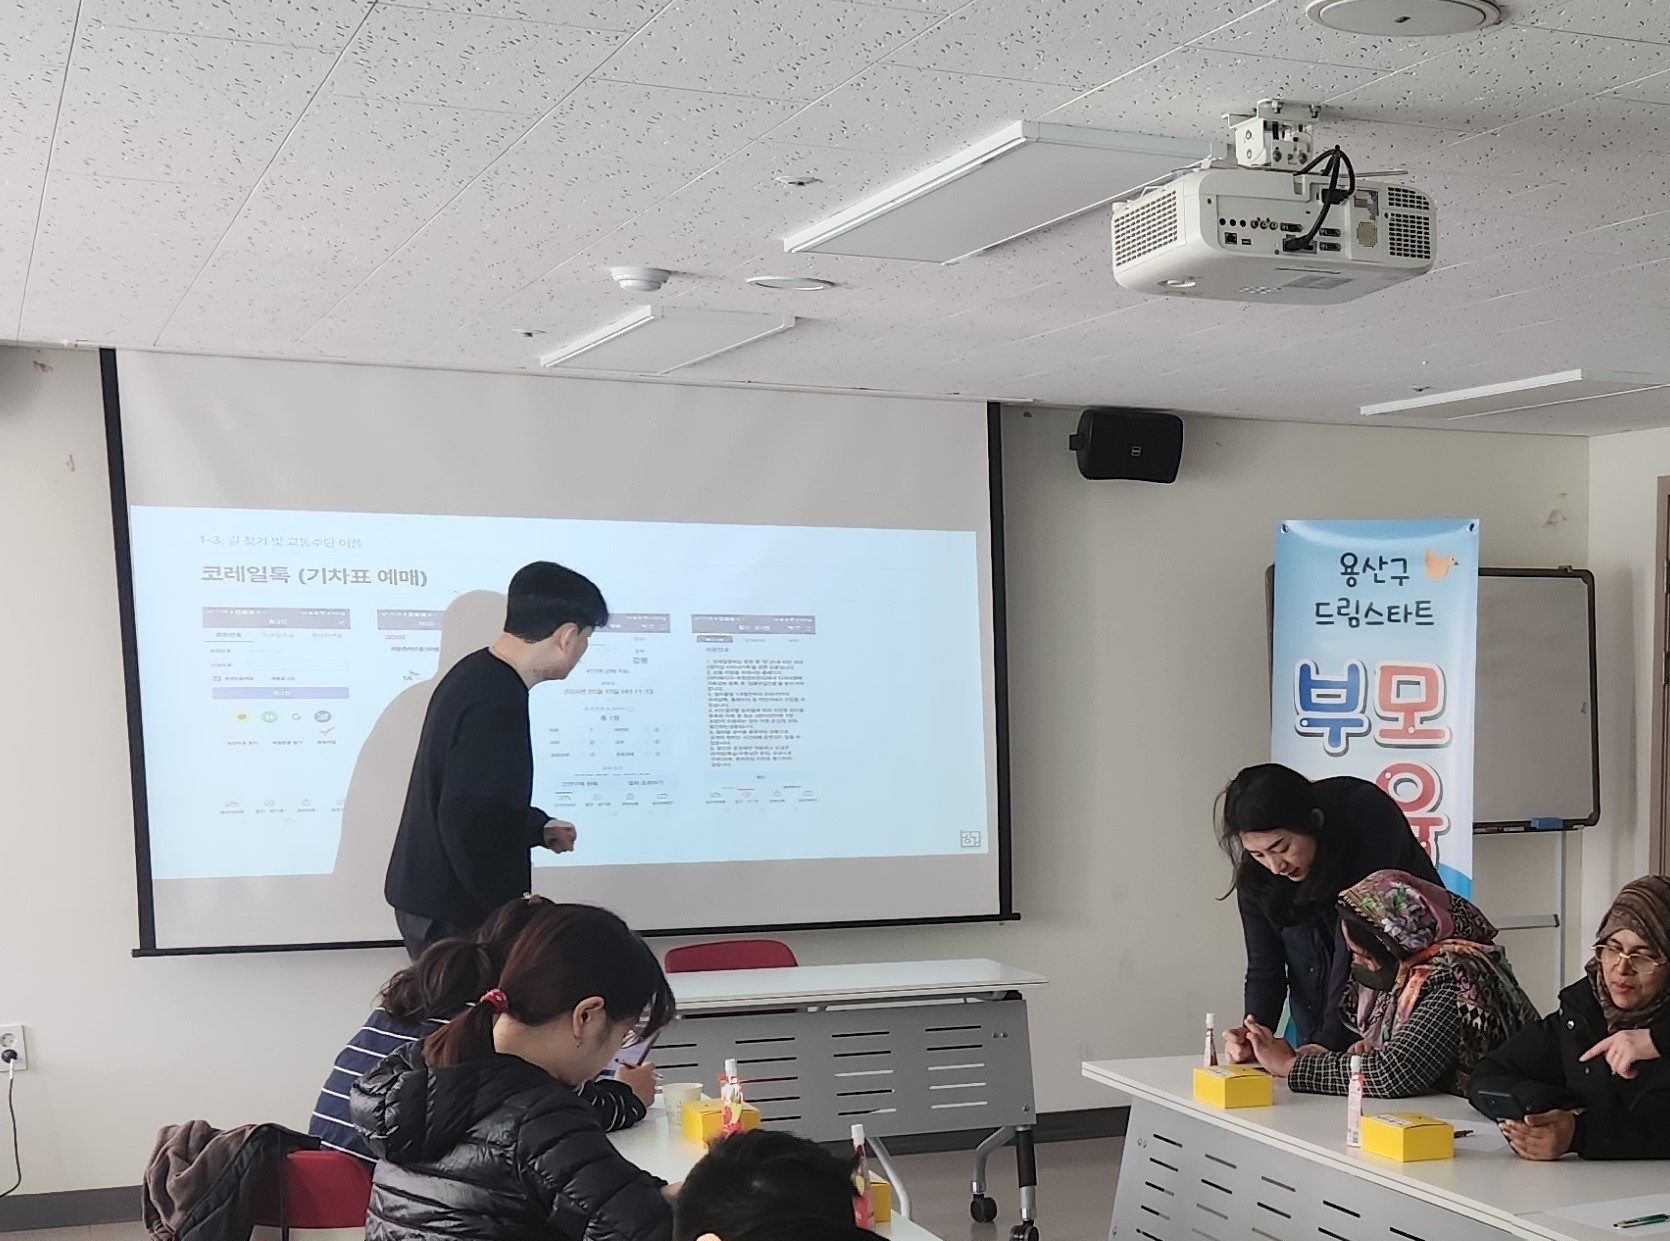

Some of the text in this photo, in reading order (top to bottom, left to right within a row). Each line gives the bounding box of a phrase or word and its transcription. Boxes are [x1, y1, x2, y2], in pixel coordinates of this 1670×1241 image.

[201, 565, 428, 587] 코레일톡 (기차표 예매)
[1340, 552, 1410, 588] 용산구
[1315, 597, 1435, 628] 드림스타트
[1294, 658, 1452, 757] 부모
